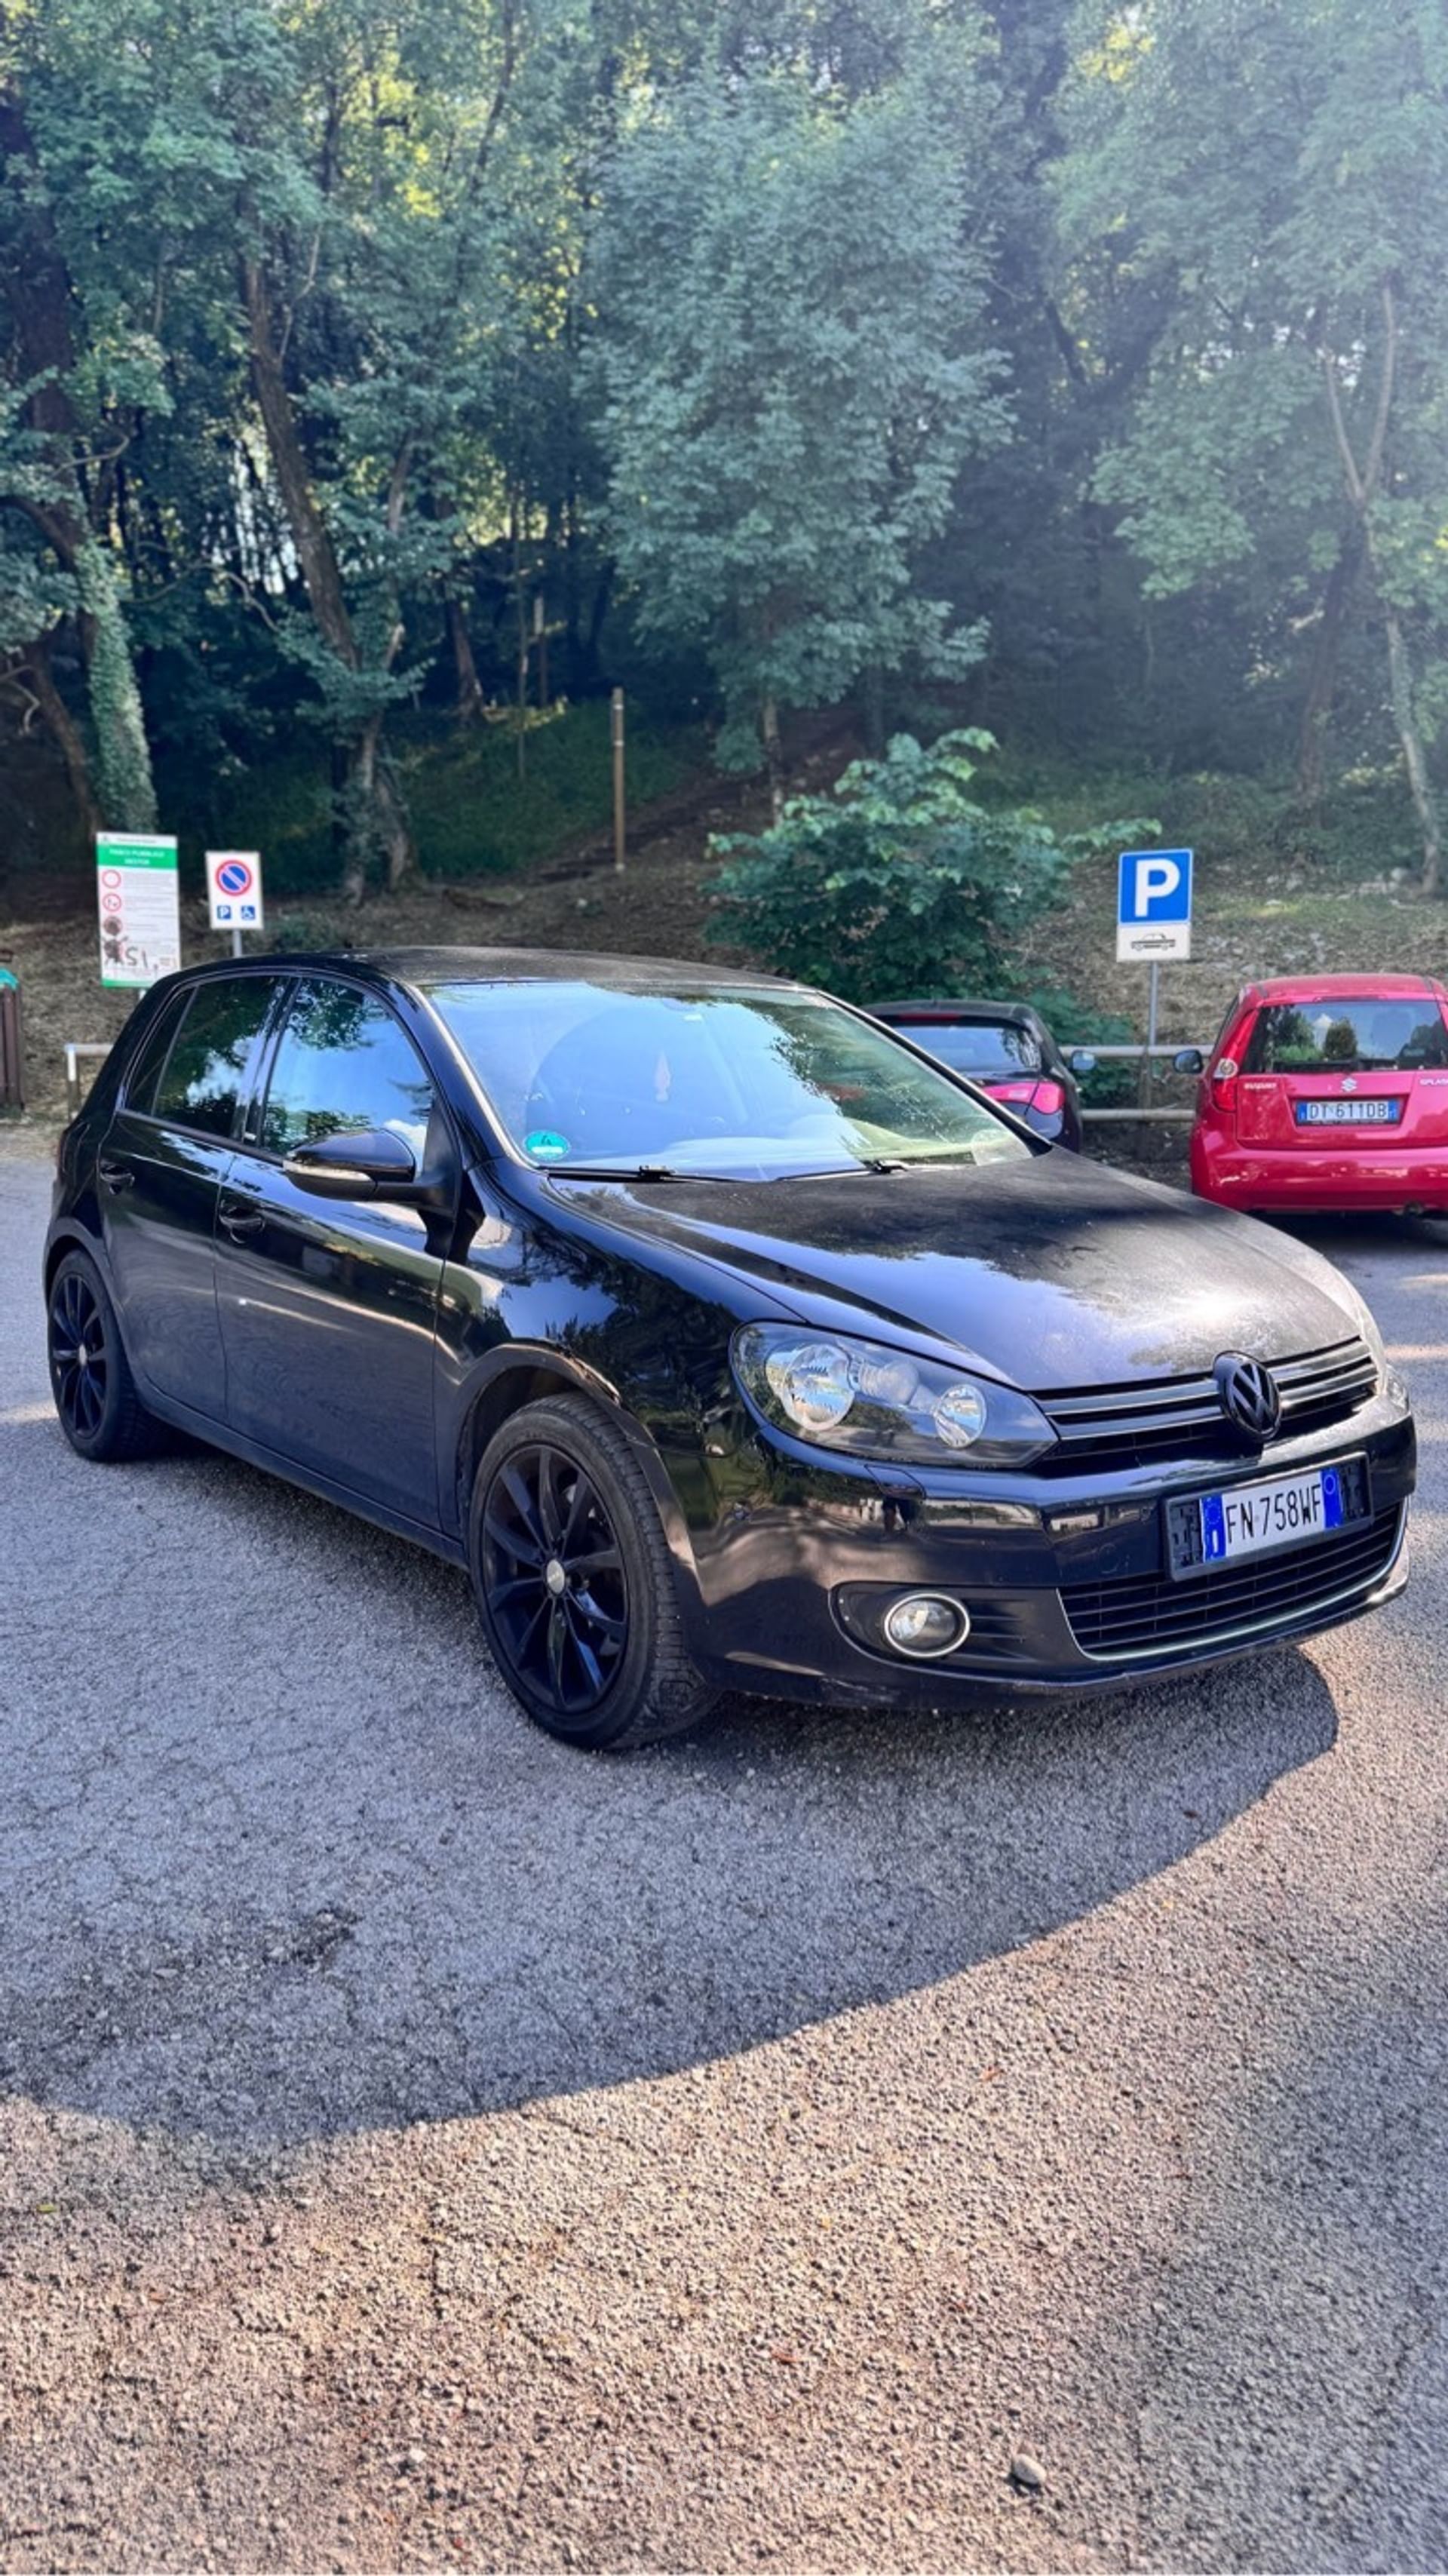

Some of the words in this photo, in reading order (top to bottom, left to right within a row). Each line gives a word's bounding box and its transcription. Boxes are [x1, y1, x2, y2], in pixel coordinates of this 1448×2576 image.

[220, 907, 229, 918] P
[1134, 858, 1181, 917] P
[1226, 1500, 1254, 1543] FN
[1260, 1484, 1321, 1536] 758WF
